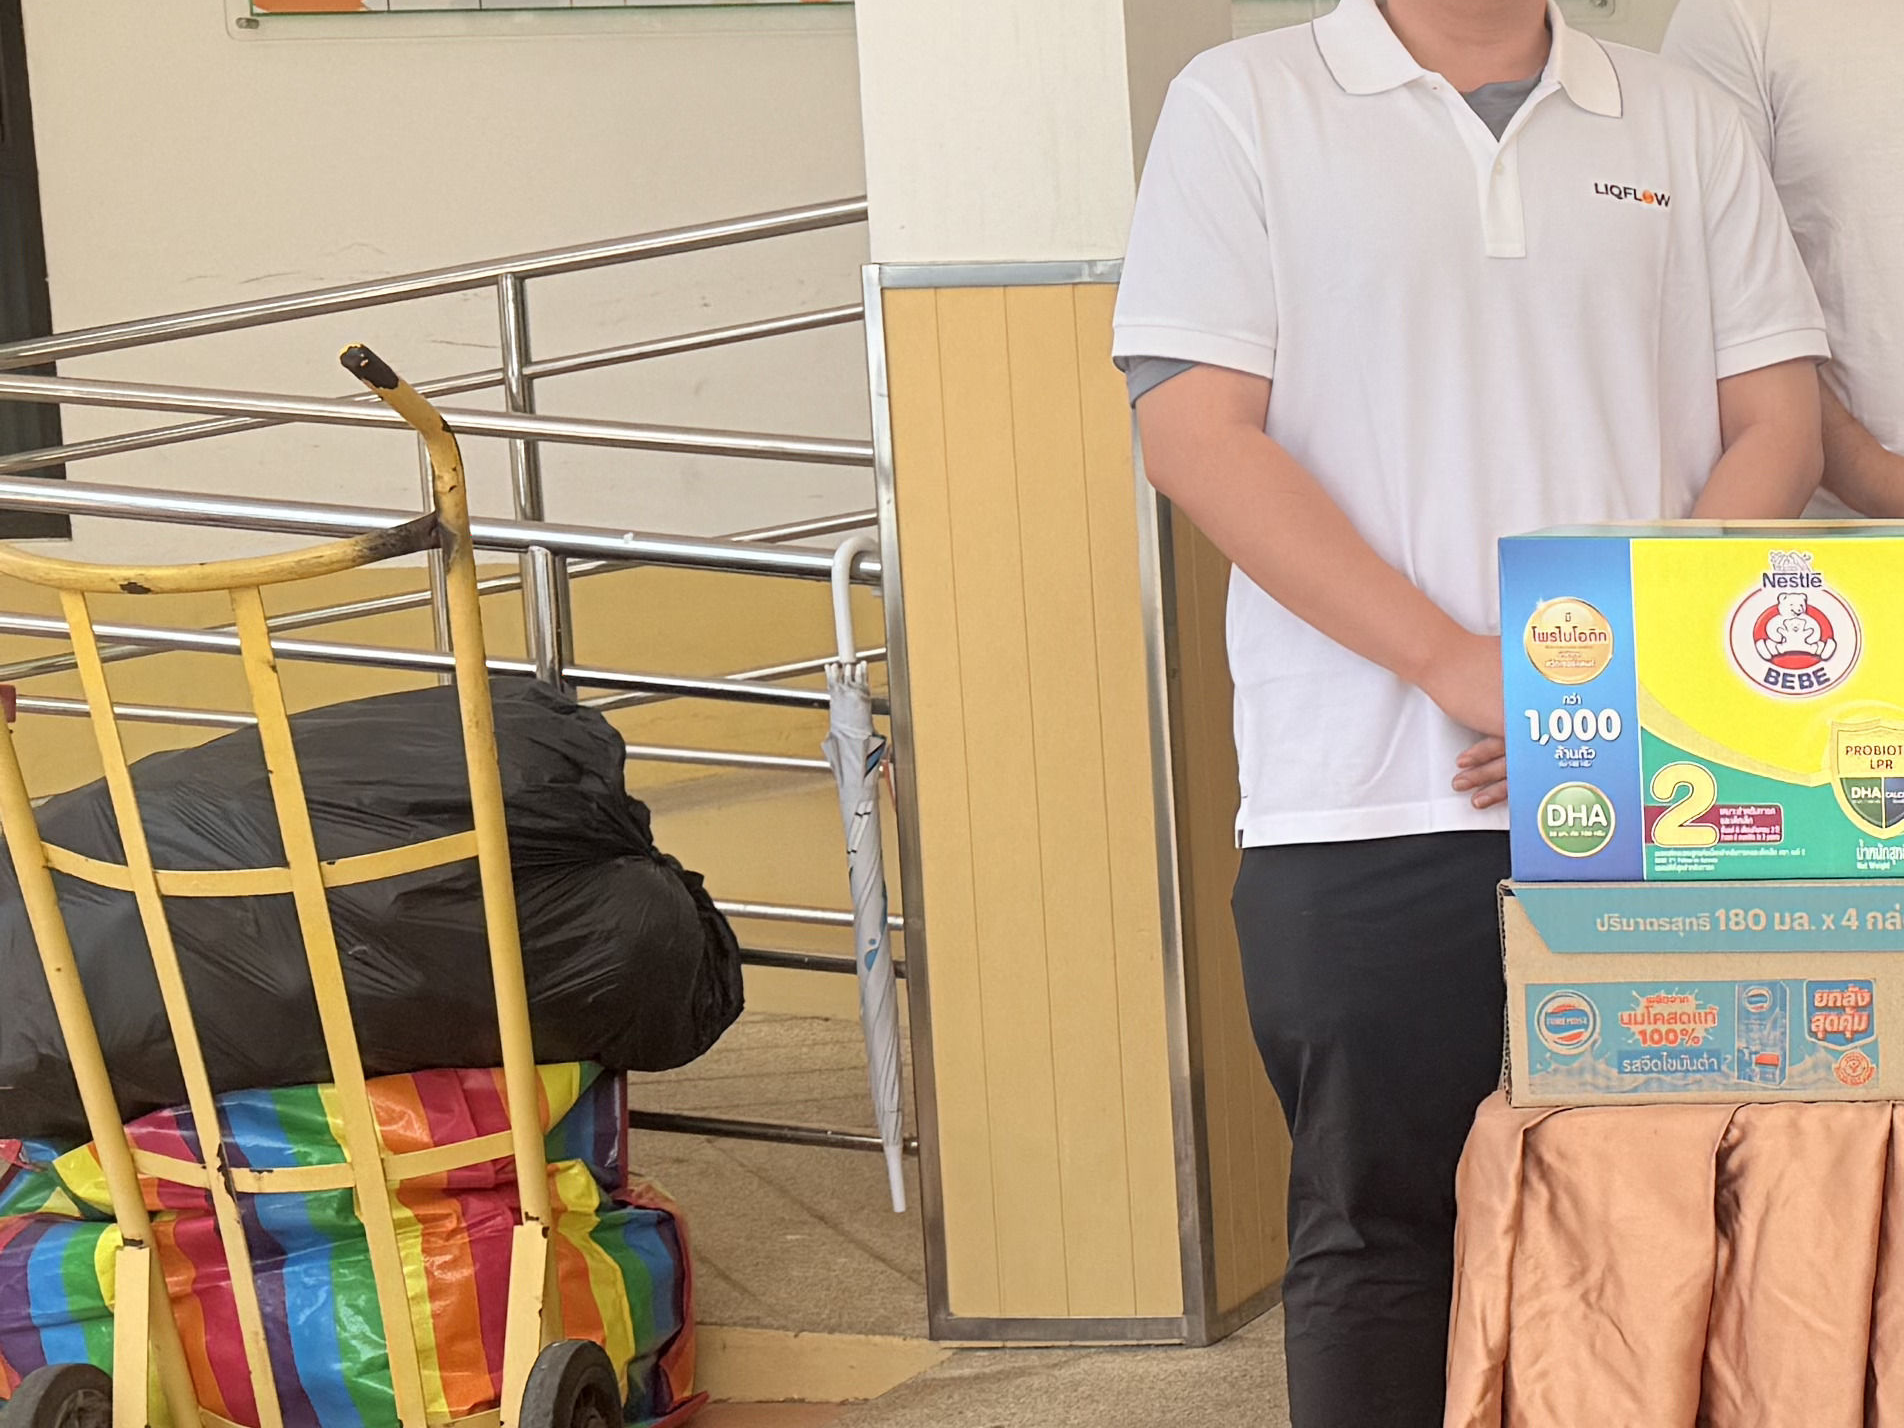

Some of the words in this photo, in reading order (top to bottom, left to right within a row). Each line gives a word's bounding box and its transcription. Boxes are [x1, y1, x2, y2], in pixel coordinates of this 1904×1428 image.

[1594, 182, 1671, 208] LIQFLOW
[1763, 665, 1832, 691] BEBE
[1523, 708, 1623, 747] 1,000
[1546, 801, 1608, 829] DHA
[1650, 761, 1719, 848] 2
[1714, 907, 1768, 933] 180
[1771, 909, 1819, 933] มล.
[1839, 908, 1860, 931] 4
